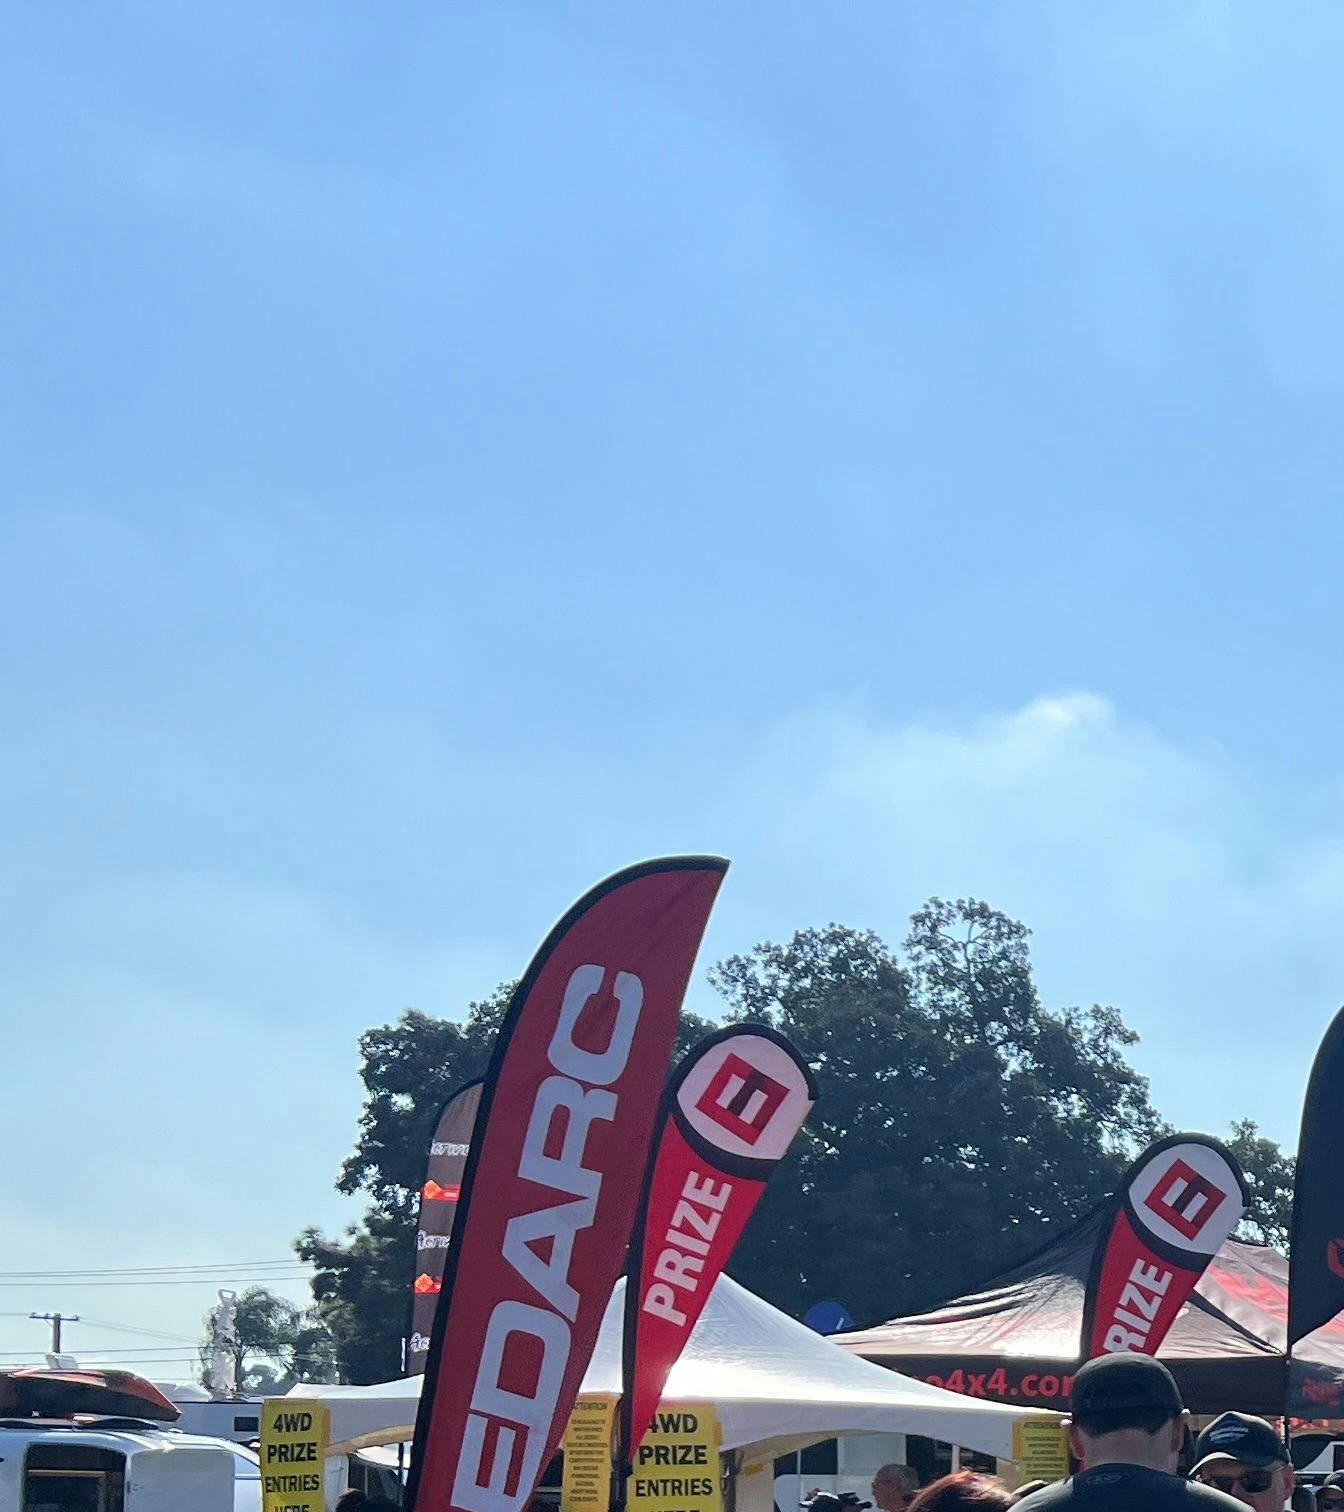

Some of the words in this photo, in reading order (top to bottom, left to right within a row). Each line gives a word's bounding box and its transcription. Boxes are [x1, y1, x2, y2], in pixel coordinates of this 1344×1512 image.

[643, 1170, 734, 1327] PRIZE
[1103, 1258, 1173, 1353] RIZE
[273, 1412, 313, 1433] 4WD
[649, 1413, 698, 1434] 4WD
[267, 1442, 318, 1463] PRIZE
[638, 1445, 708, 1465] PRIZE
[265, 1474, 320, 1493] ENTRIES
[635, 1478, 713, 1497] ENTRIES
